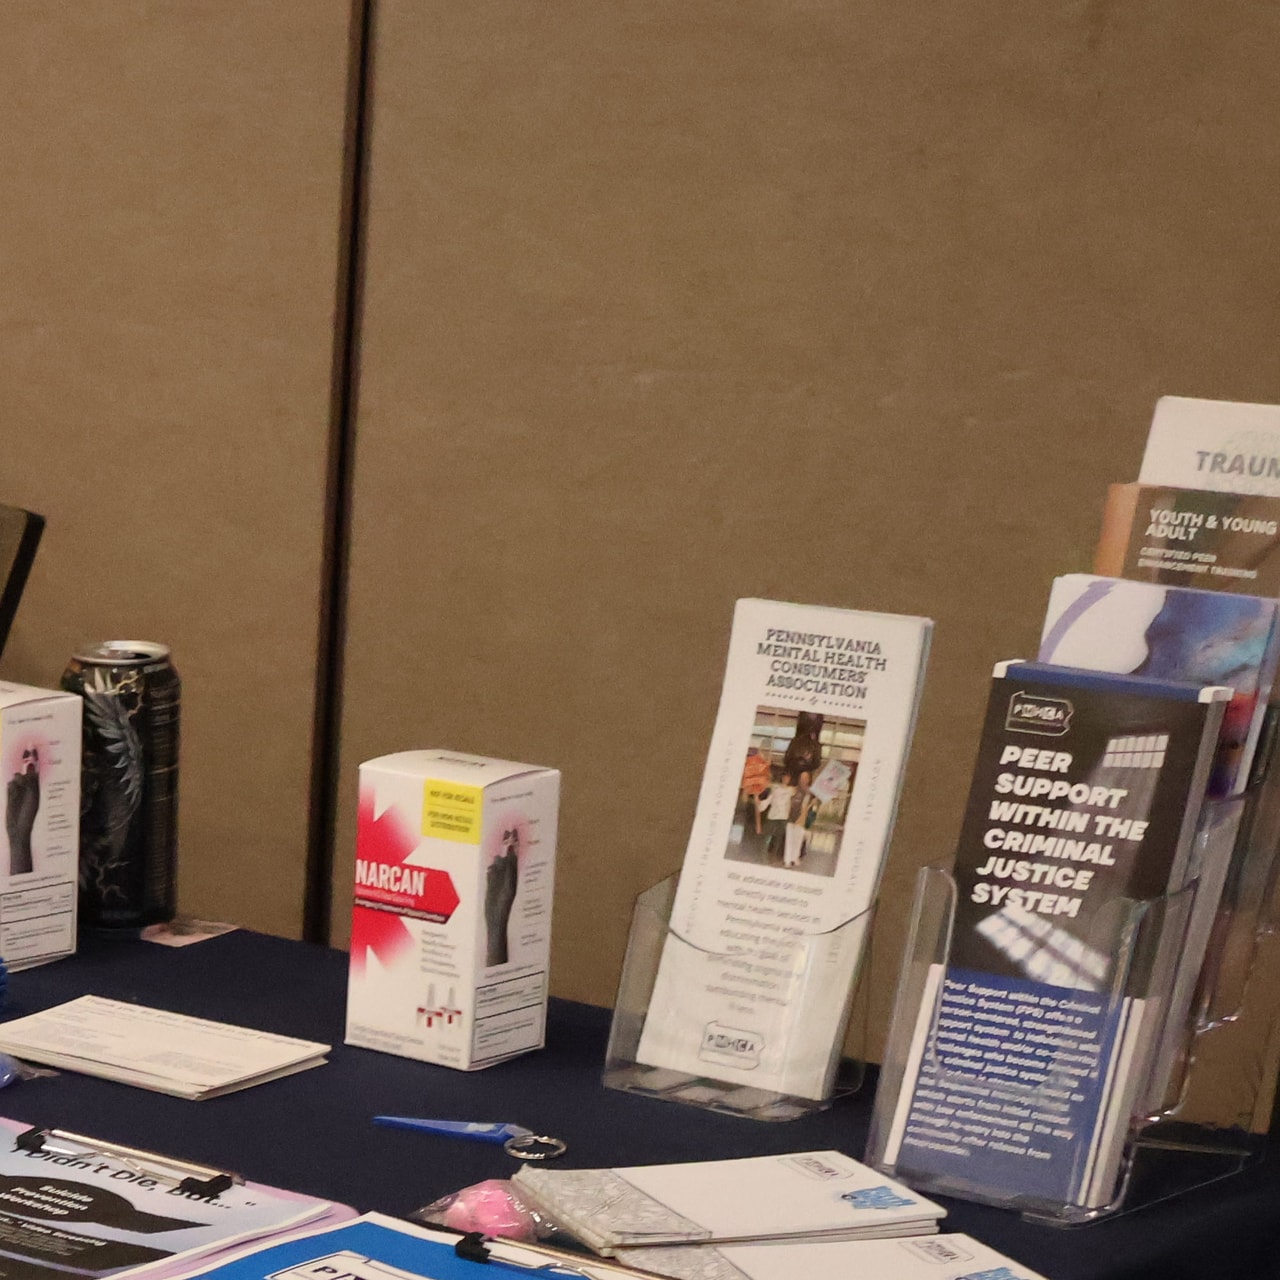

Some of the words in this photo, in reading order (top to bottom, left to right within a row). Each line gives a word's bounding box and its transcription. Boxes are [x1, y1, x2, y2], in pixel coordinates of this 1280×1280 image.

[1145, 525, 1198, 541] ADULT
[1150, 509, 1203, 527] YOUTH
[1205, 515, 1218, 529] &
[1222, 517, 1278, 535] YOUNG
[766, 629, 881, 655] PENNSYLVANIA
[757, 642, 820, 663] MENTAL
[824, 651, 887, 671] HEALTH
[766, 674, 868, 699] ASSOCIATION
[1000, 746, 1072, 773] PEER
[995, 773, 1127, 809] SUPPORT
[989, 801, 1090, 833] WITHIN
[1095, 816, 1149, 841] THE
[984, 828, 1115, 866] CRIMINAL
[355, 859, 426, 897] NARCAN
[976, 856, 1095, 890] JUSTICE
[971, 883, 1082, 917] SYSTEM
[939, 1019, 973, 1029] upport
[109, 1168, 158, 1191] Die,
[10, 1187, 88, 1211] Prevention
[39, 1185, 94, 1203] Suicide
